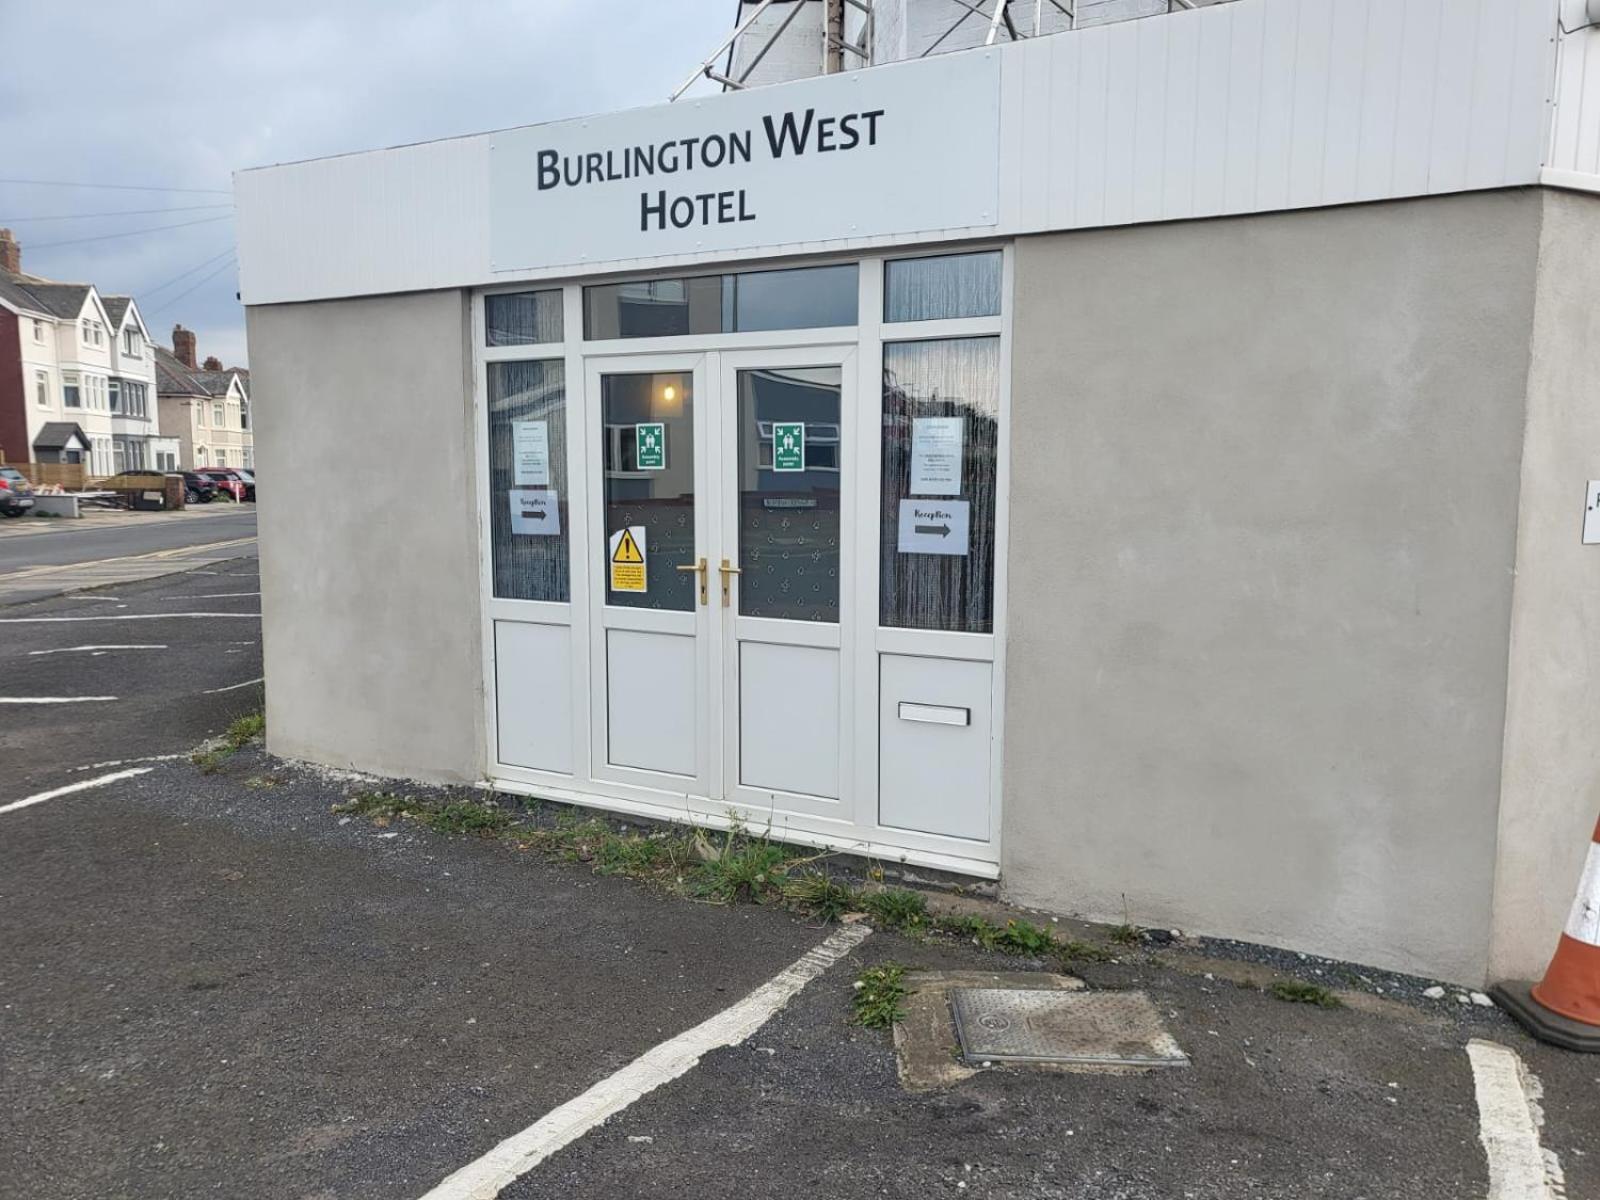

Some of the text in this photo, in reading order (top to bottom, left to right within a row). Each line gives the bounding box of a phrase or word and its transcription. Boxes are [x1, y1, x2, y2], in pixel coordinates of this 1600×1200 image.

[537, 108, 884, 190] BURLINGTON WEST
[640, 189, 756, 231] HOTEL
[914, 509, 952, 521] Reception
